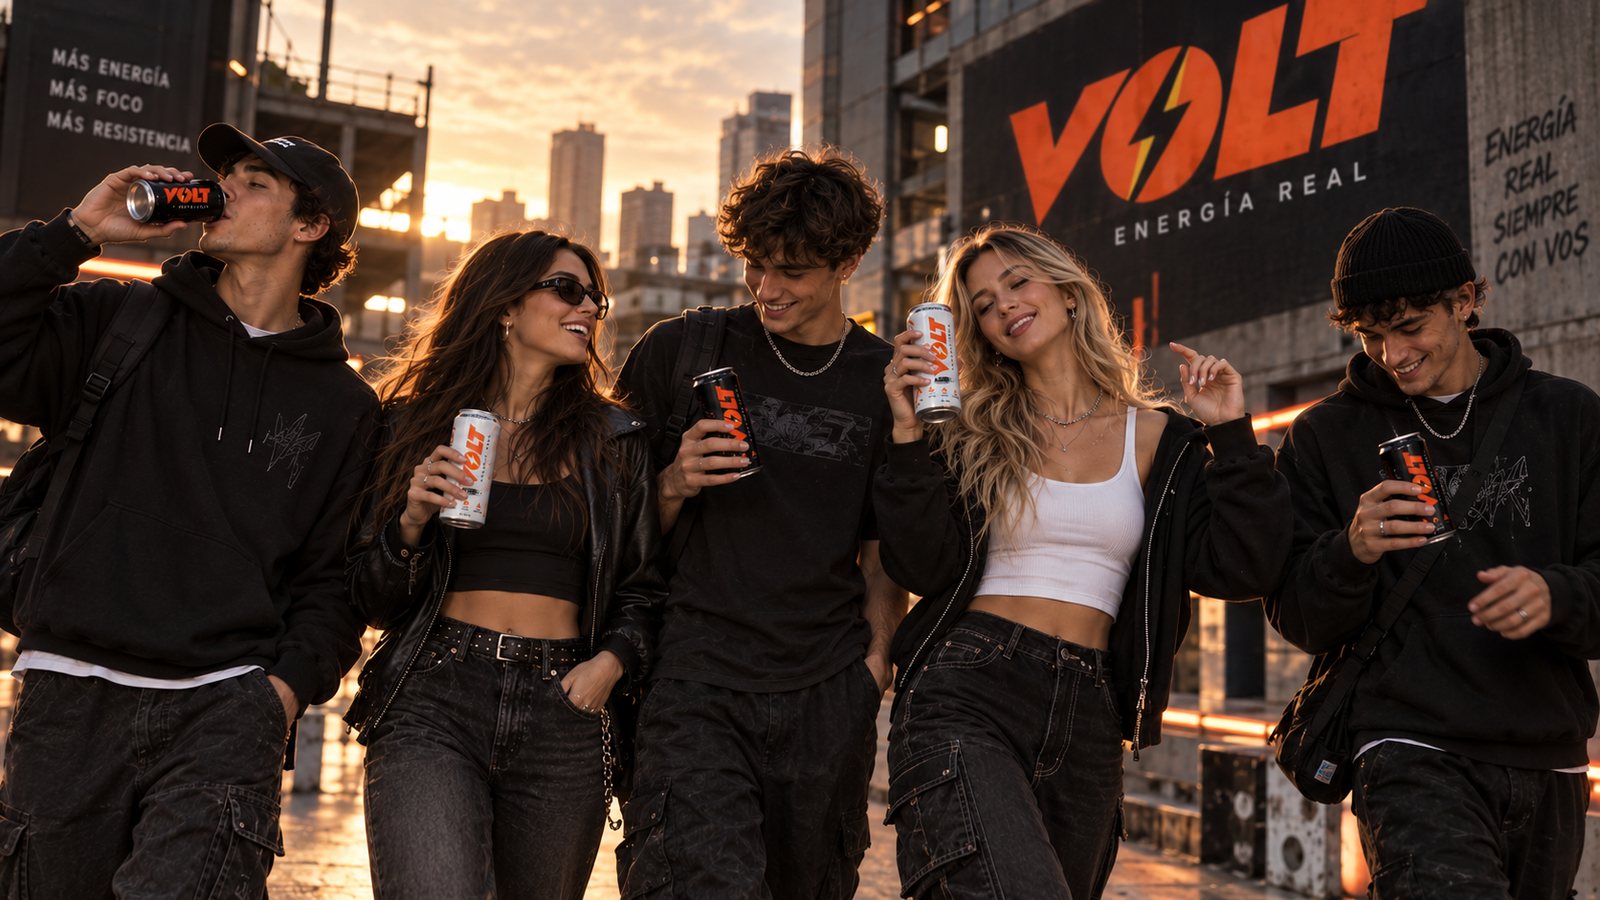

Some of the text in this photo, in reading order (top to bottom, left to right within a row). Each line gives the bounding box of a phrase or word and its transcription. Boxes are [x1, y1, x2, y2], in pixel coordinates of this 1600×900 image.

[52, 47, 170, 89] MÁS ENERGÍA
[49, 79, 144, 114] MÁS FOCO
[1009, 0, 1428, 228] VOLT
[46, 108, 192, 154] MÁS RESISTENCIA
[1485, 94, 1578, 167] ENERGÍA
[163, 187, 211, 204] VOLT
[1504, 151, 1559, 199] REAL
[1114, 161, 1367, 246] ENERGÍA REAL
[1493, 183, 1580, 245] SIEMPRE
[1495, 220, 1589, 286] CON VOS
